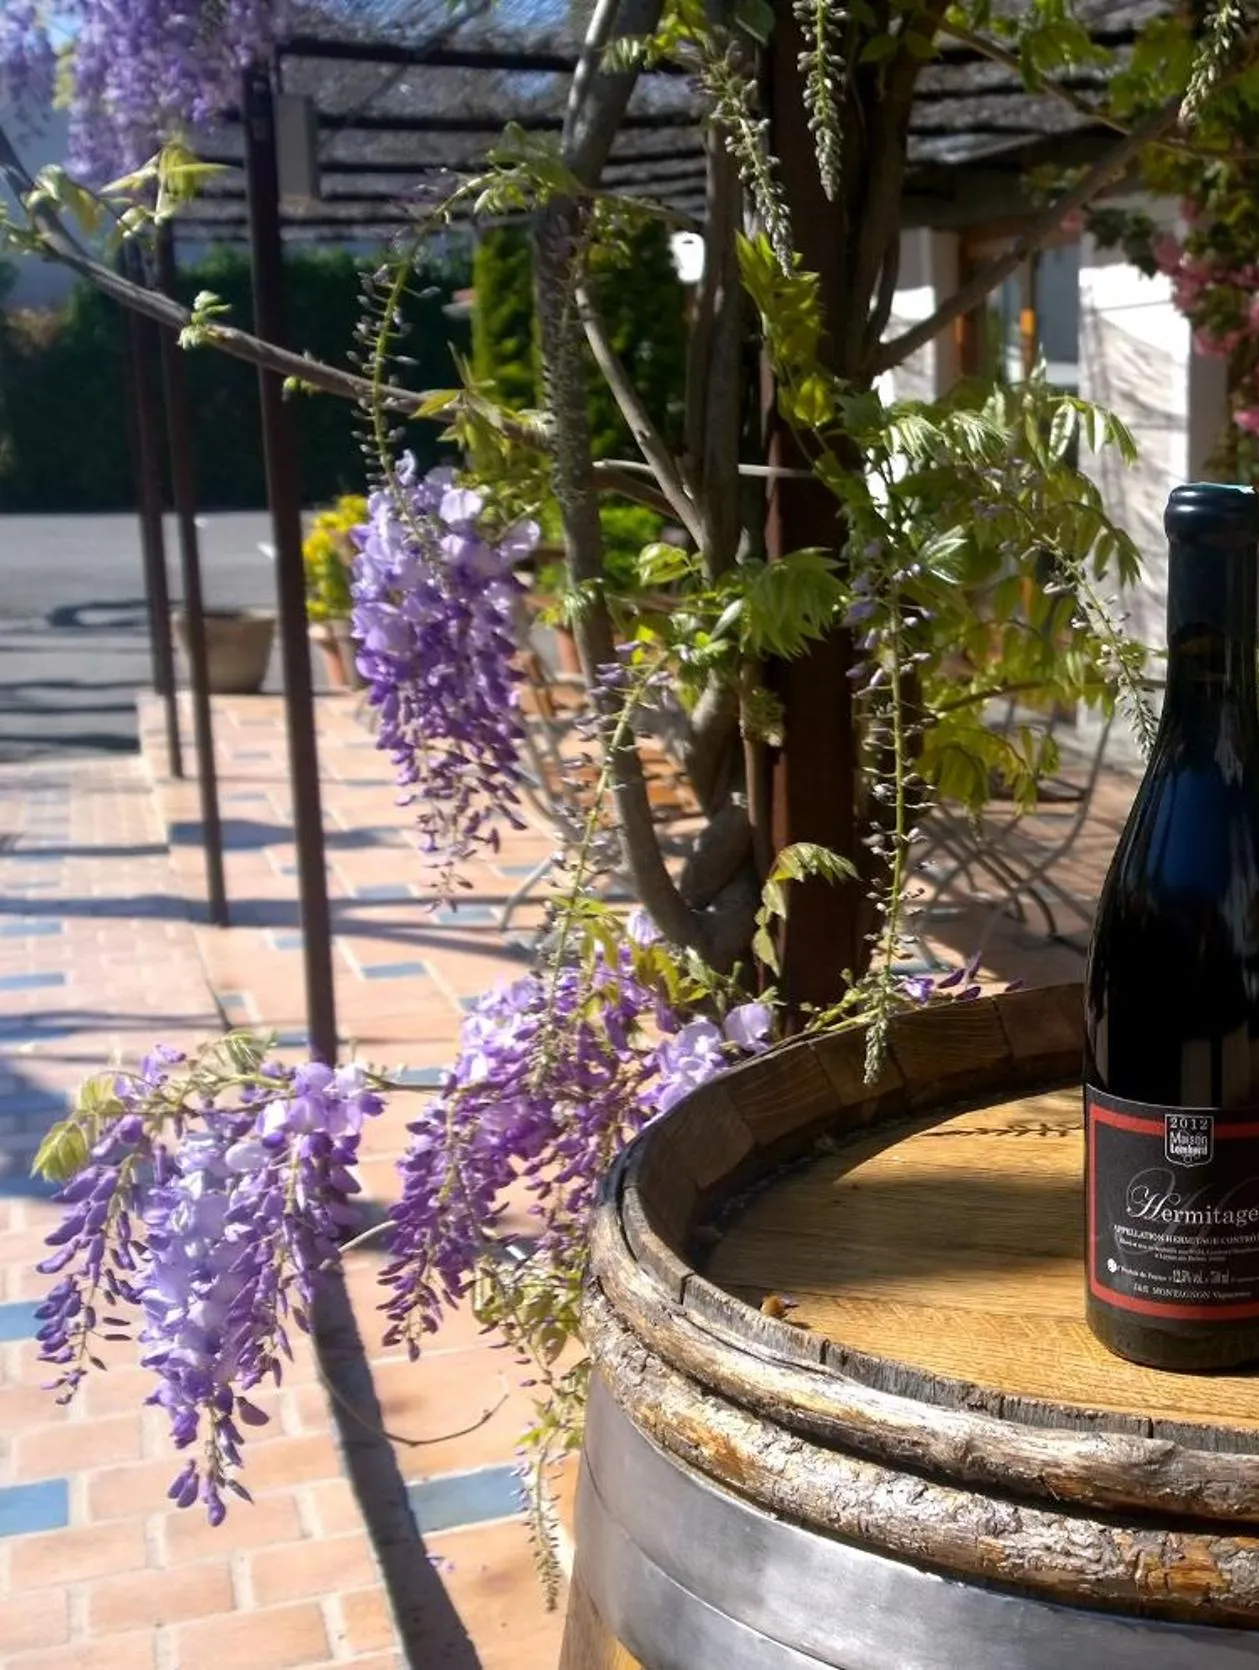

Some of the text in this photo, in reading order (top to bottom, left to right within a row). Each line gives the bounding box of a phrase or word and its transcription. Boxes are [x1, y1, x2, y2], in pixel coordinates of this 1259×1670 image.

[1169, 1117, 1208, 1130] 2012
[1169, 1131, 1208, 1145] Maison
[1126, 1185, 1259, 1227] Hermitage
